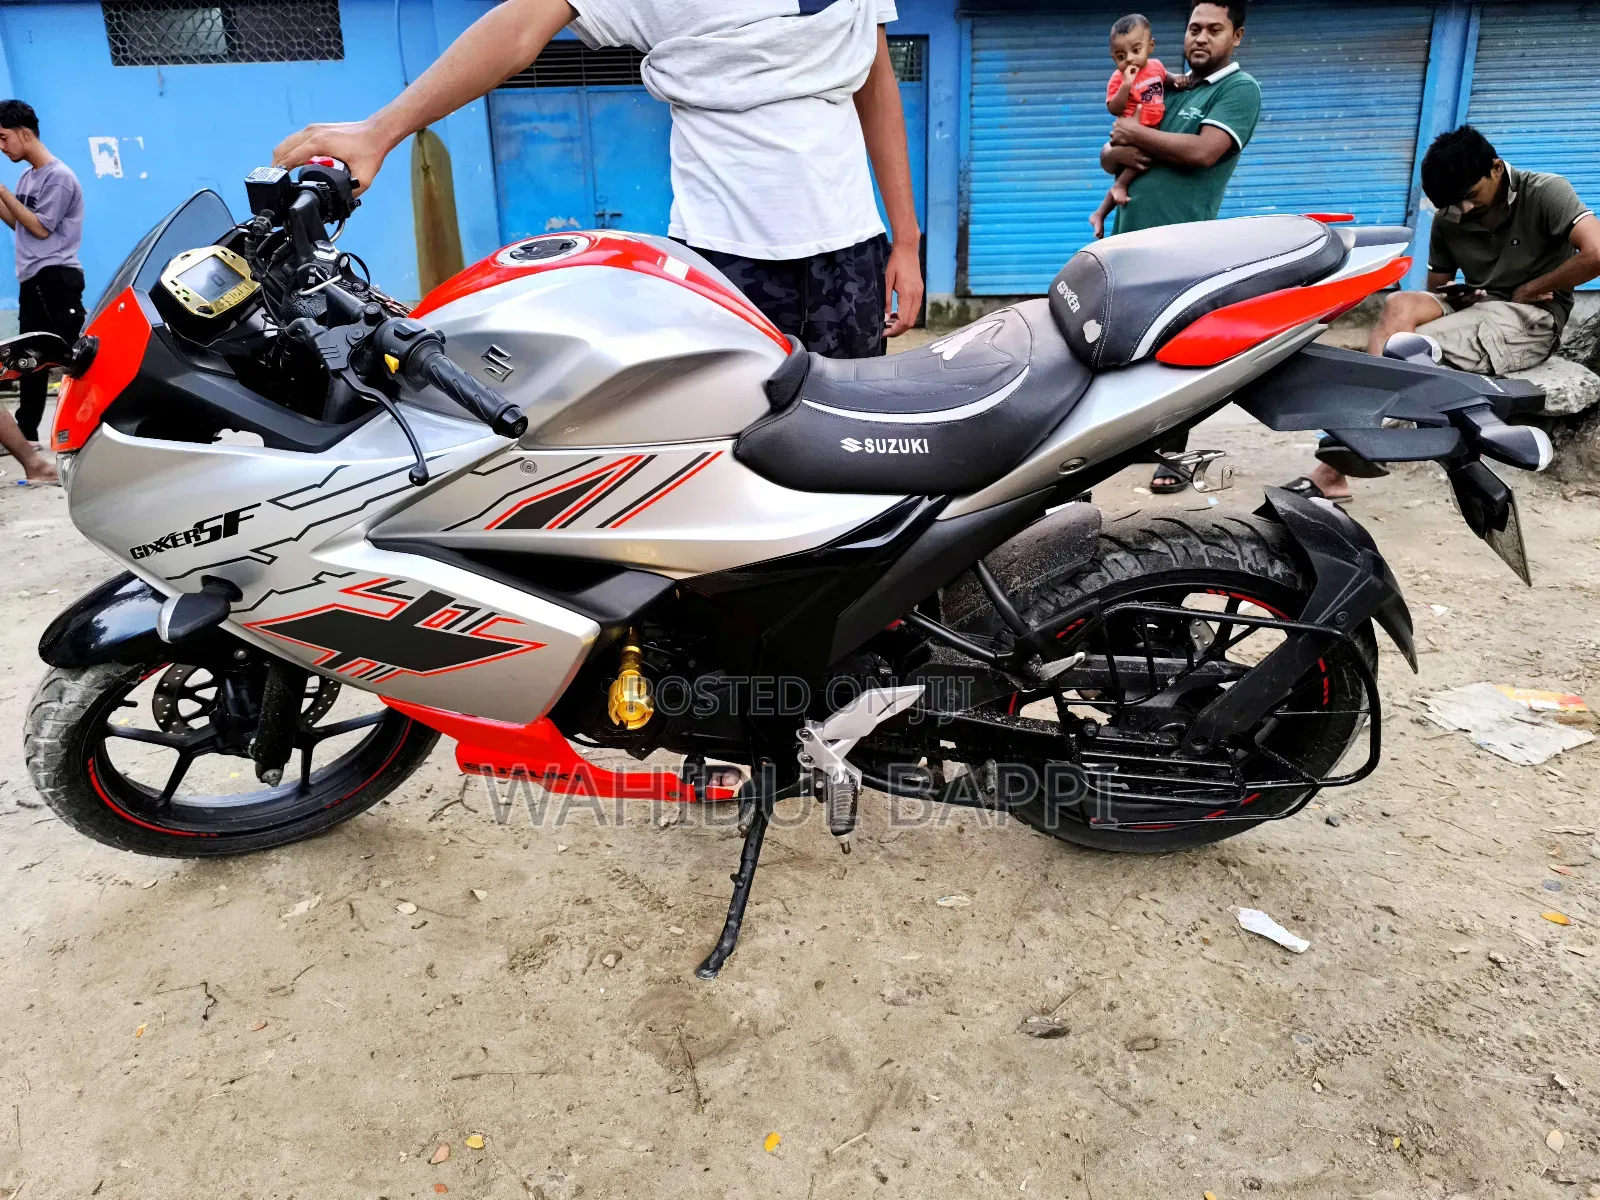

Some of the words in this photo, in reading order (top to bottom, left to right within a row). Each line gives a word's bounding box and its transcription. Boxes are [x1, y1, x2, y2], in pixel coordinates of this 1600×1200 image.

[1057, 281, 1081, 313] GIXXER
[864, 438, 930, 453] SUZUKI
[130, 528, 202, 560] GIXXER
[193, 502, 262, 547] SF
